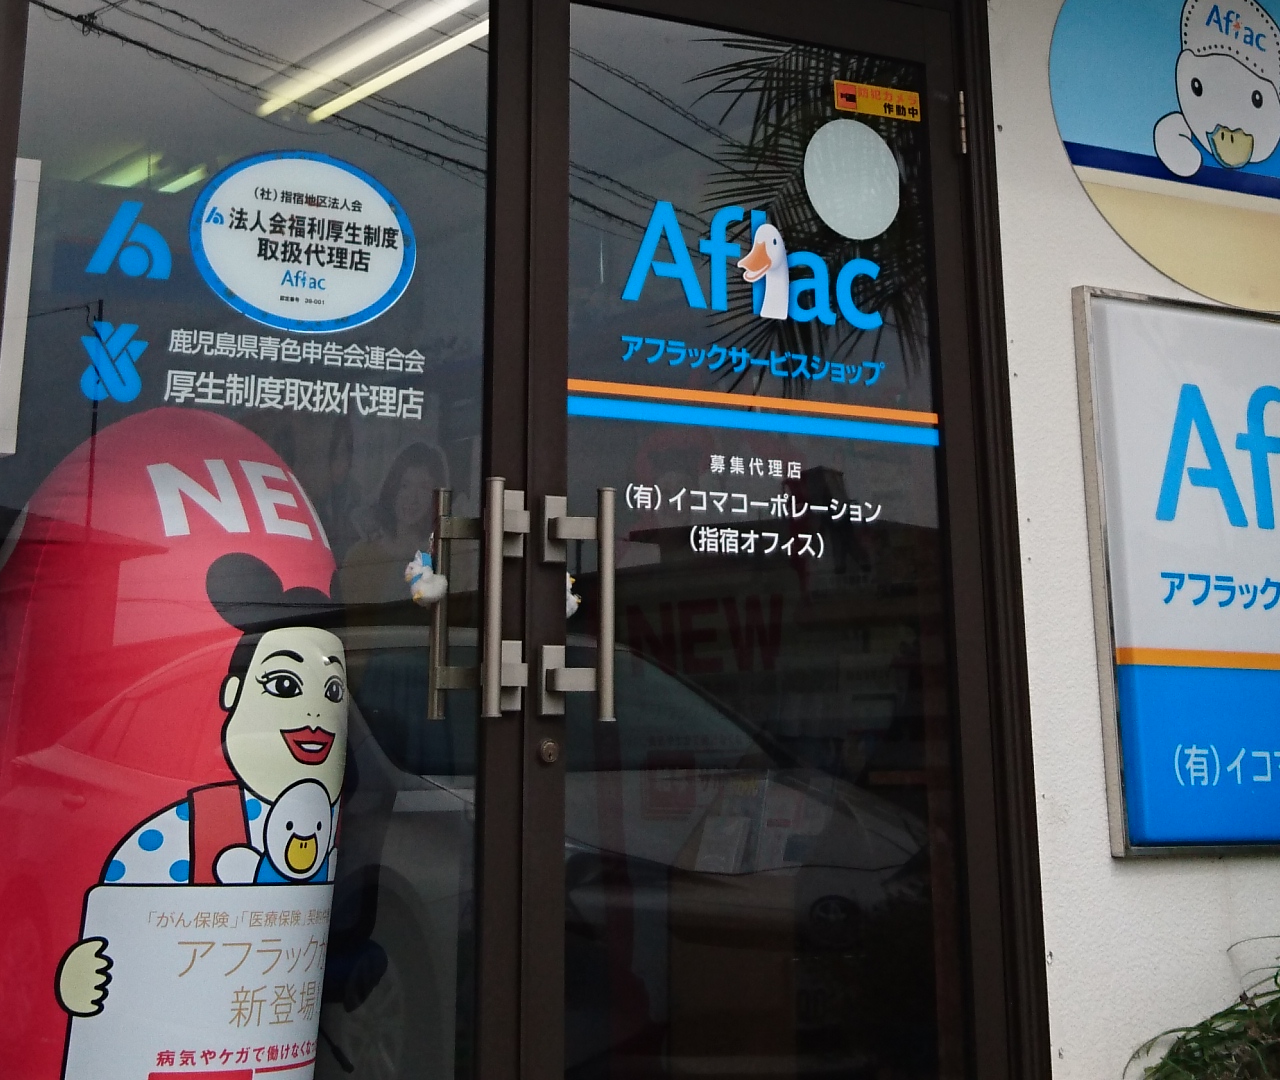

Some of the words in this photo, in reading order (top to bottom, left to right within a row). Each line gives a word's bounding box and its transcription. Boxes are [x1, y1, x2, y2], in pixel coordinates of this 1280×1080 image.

[1205, 4, 1266, 52] Aflac
[883, 102, 919, 119] 作動中
[228, 206, 400, 251] 法人会福利厚生制度
[257, 237, 371, 273] 取扱代理店
[622, 200, 883, 331] Aflac
[280, 269, 326, 291] Aflac
[168, 328, 426, 374] 鹿児島県青色申告会連合会
[621, 334, 886, 387] アフラックサービスショップ
[163, 368, 425, 421] 厚生制度取扱代理店
[709, 453, 802, 480] 募集代理店
[147, 459, 331, 550] NE
[624, 483, 883, 523] (有)イコマコーポレーション
[689, 525, 825, 559] (指宿オフィス)
